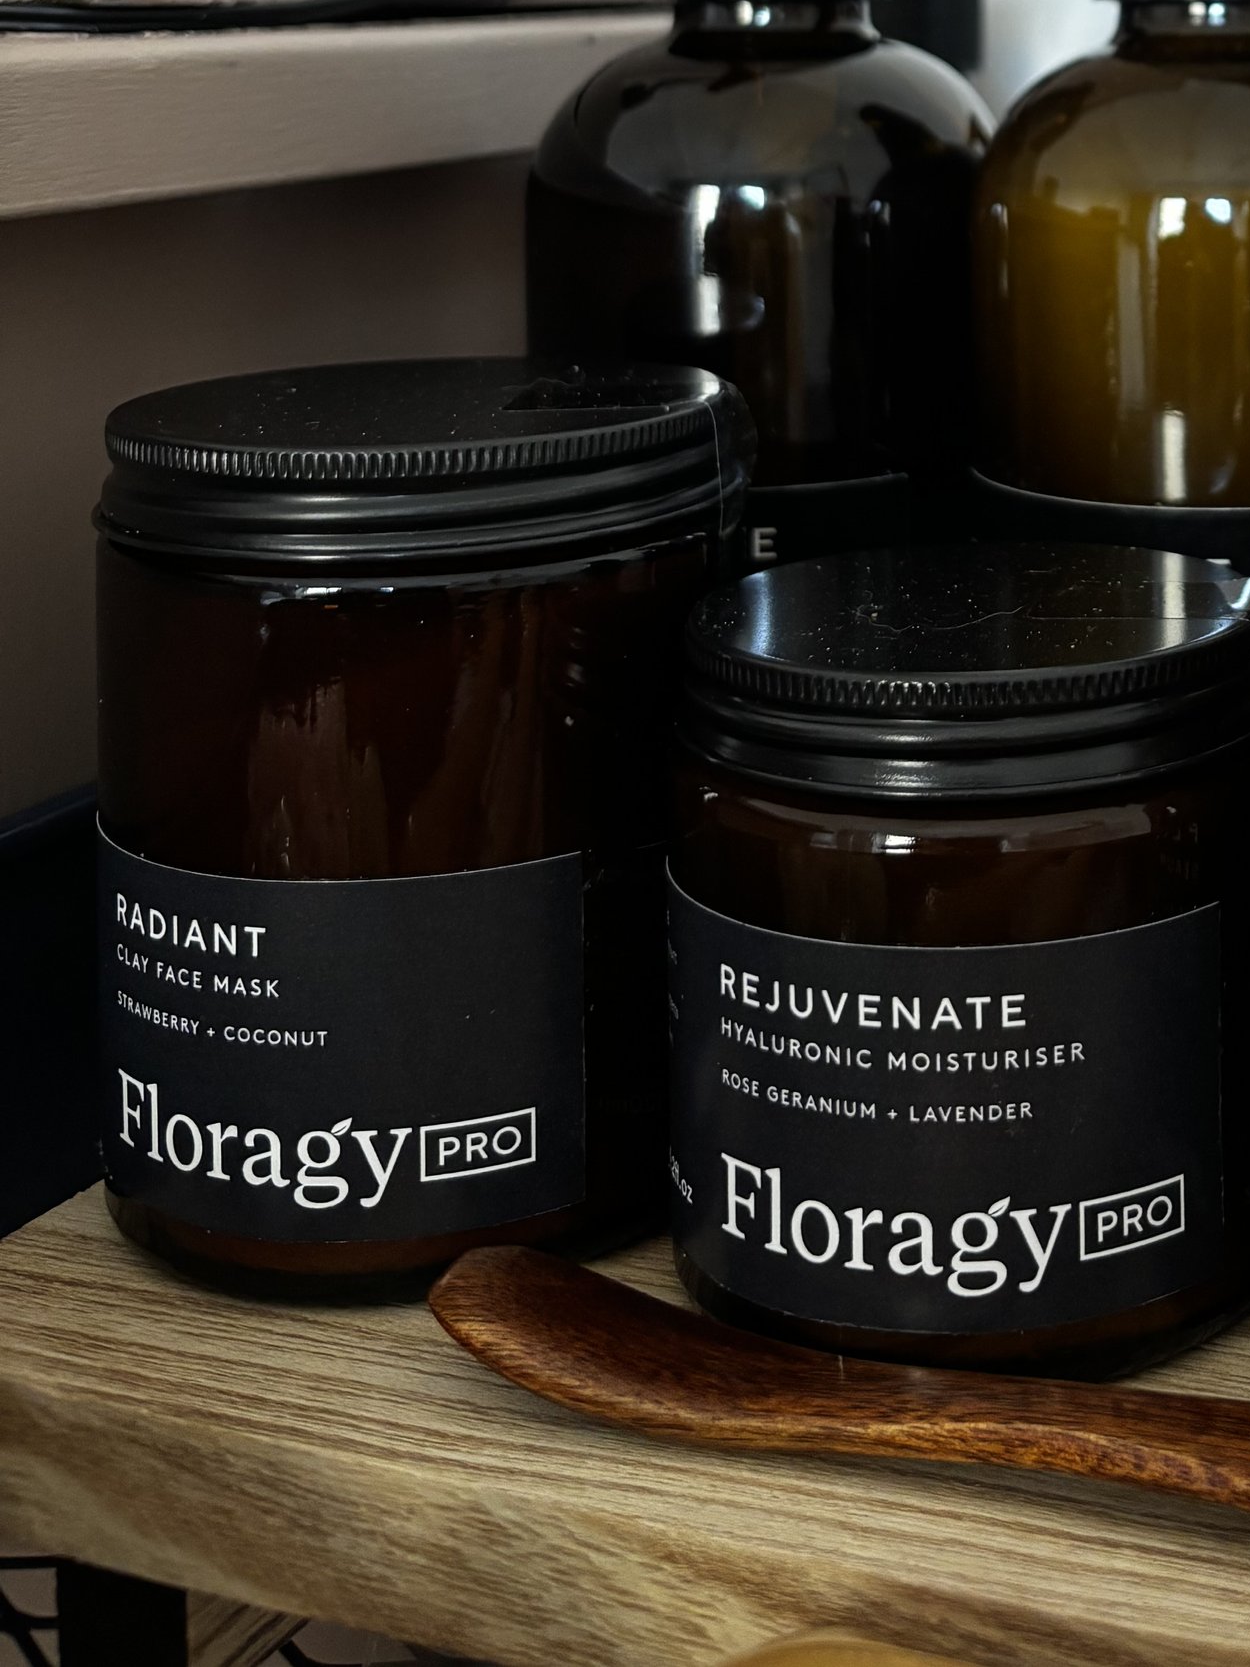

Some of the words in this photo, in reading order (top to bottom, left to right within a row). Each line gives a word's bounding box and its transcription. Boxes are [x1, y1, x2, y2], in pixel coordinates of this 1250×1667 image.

[117, 892, 266, 958] RADIANT
[117, 943, 149, 974] CLAY
[156, 961, 203, 989] FACE
[213, 974, 280, 998] MASK
[720, 963, 1026, 1031] REJUVENATE
[117, 990, 200, 1035] STRAWBERRY
[223, 1025, 328, 1047] COCONUT
[721, 1016, 872, 1069] HYALURONIC
[887, 1042, 1085, 1072] MOISTURISER
[722, 1068, 760, 1097] ROSE
[766, 1085, 876, 1119] GERANIUM
[909, 1102, 1033, 1123] LAVENDER
[118, 1068, 413, 1210] Floragy
[721, 1152, 1071, 1298] Floragy
